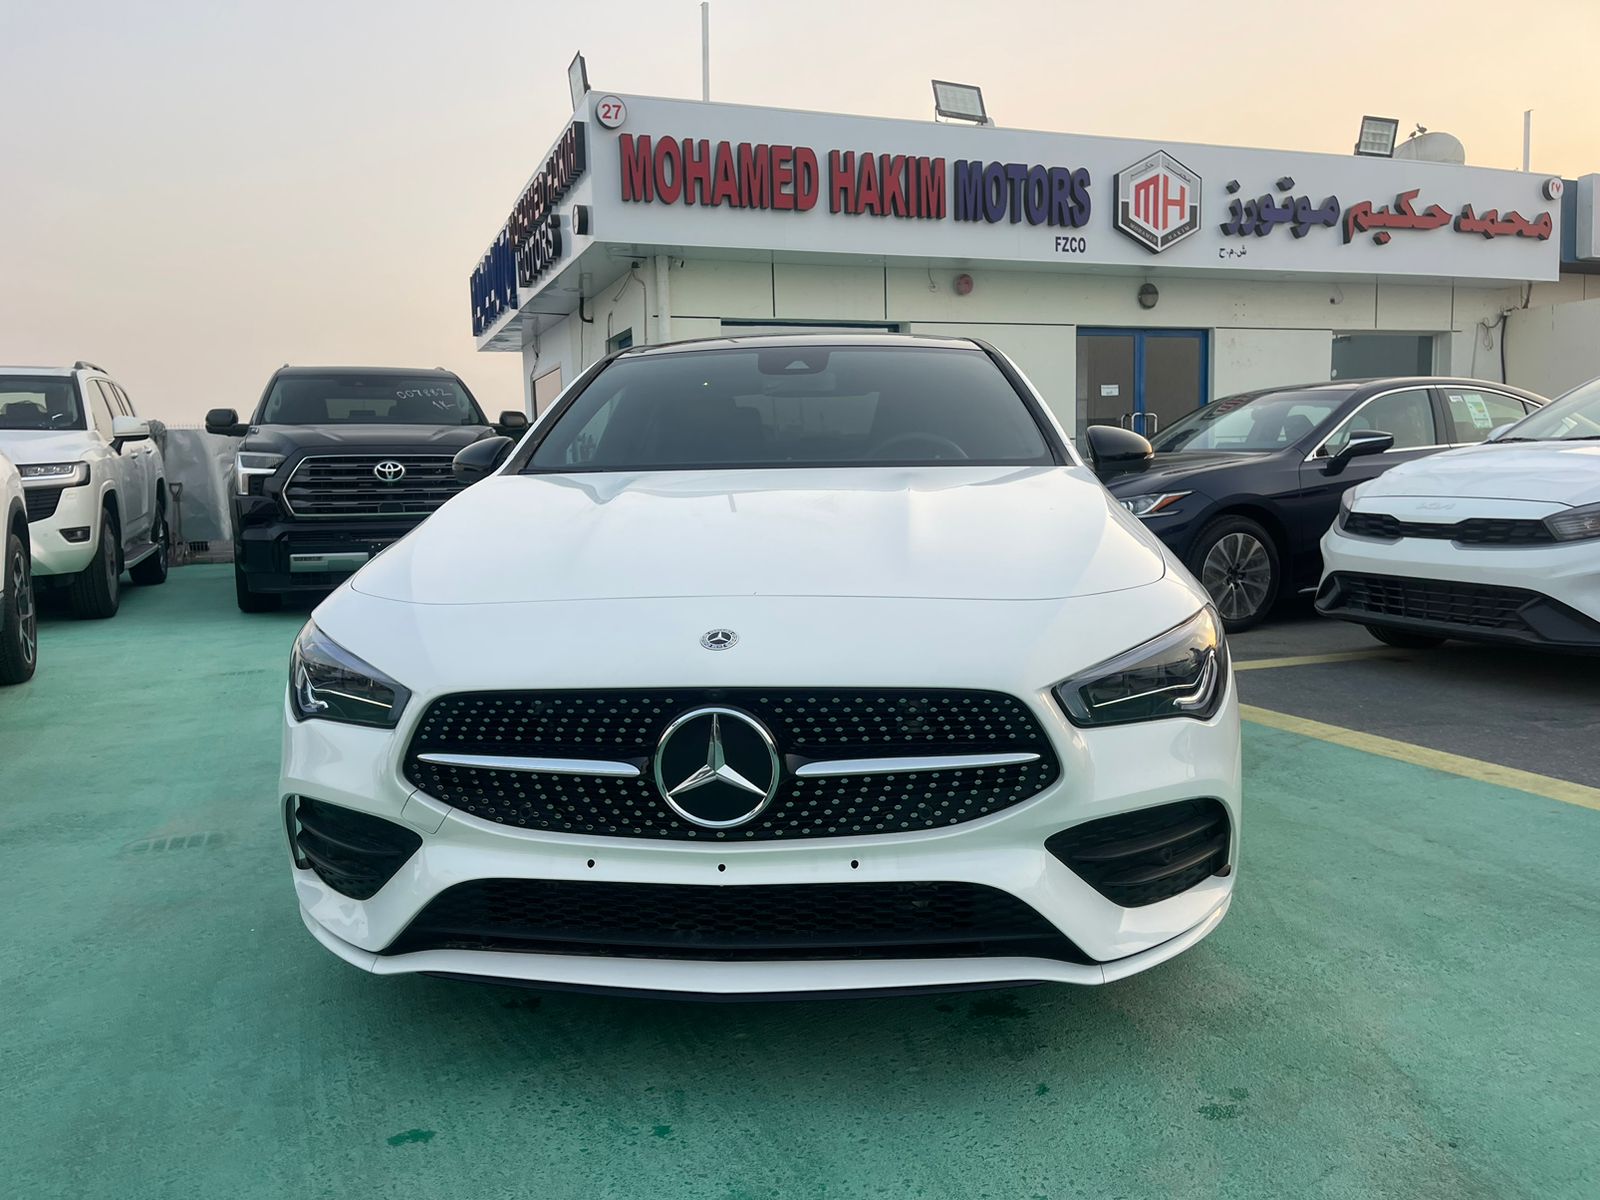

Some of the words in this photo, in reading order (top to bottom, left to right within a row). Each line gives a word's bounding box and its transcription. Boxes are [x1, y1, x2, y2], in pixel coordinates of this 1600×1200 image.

[602, 104, 622, 120] 27
[619, 133, 819, 212] MOHAMED
[828, 150, 946, 220] HAKIM
[954, 159, 1091, 228] MOTORS
[1135, 173, 1185, 230] MH
[1219, 176, 1341, 239] موتورز
[1055, 236, 1086, 253] FZCO
[1342, 188, 1453, 245] حكيم
[1453, 203, 1552, 241] محمد
[518, 213, 562, 288] MOTORS
